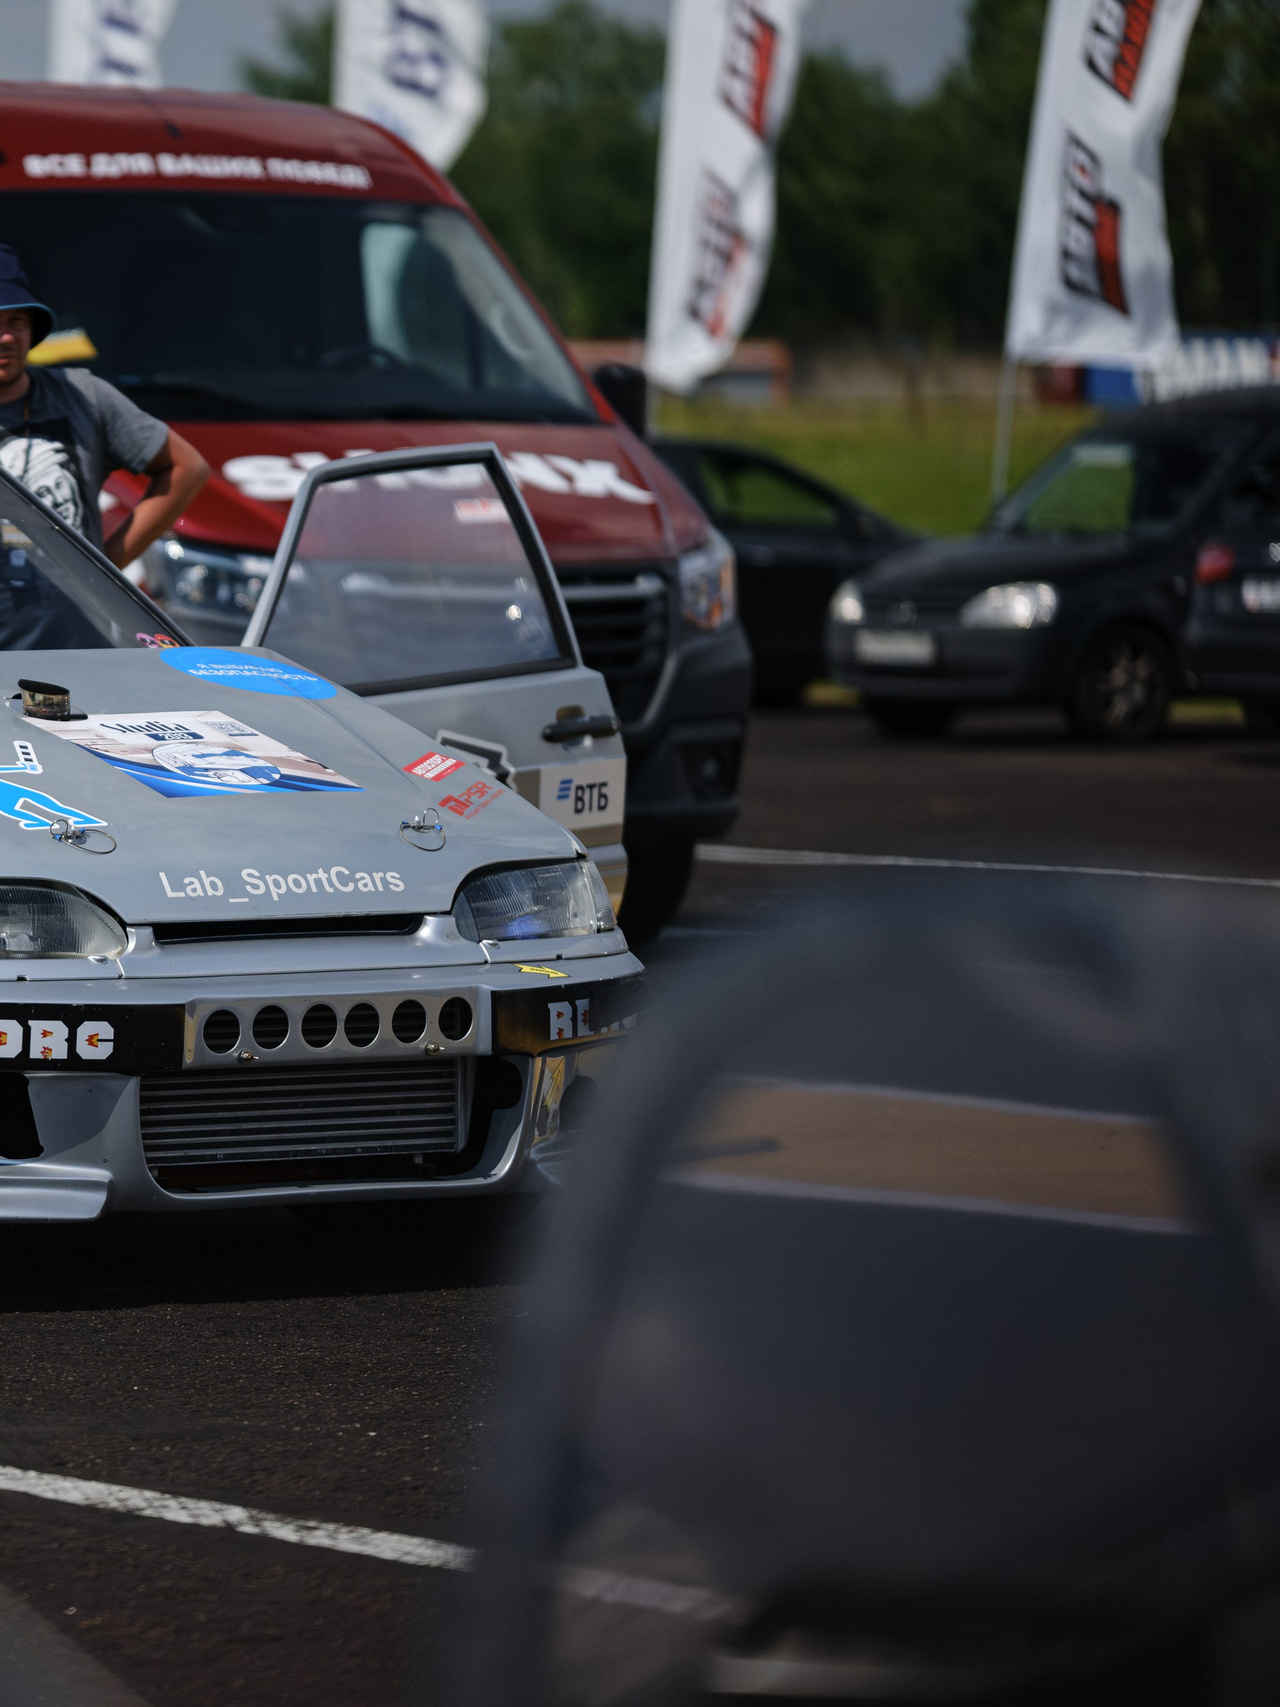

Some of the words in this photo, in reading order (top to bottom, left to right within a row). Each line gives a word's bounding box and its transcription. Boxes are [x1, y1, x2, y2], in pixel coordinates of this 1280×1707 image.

[22, 152, 88, 179] ВСЕ
[88, 151, 156, 180] ДЛЯ
[156, 151, 266, 181] ВАШИХ
[265, 156, 373, 190] ПОБЕД
[458, 781, 494, 805] PSR
[574, 782, 608, 814] ВТБ
[158, 866, 406, 903] Lab_SportCars
